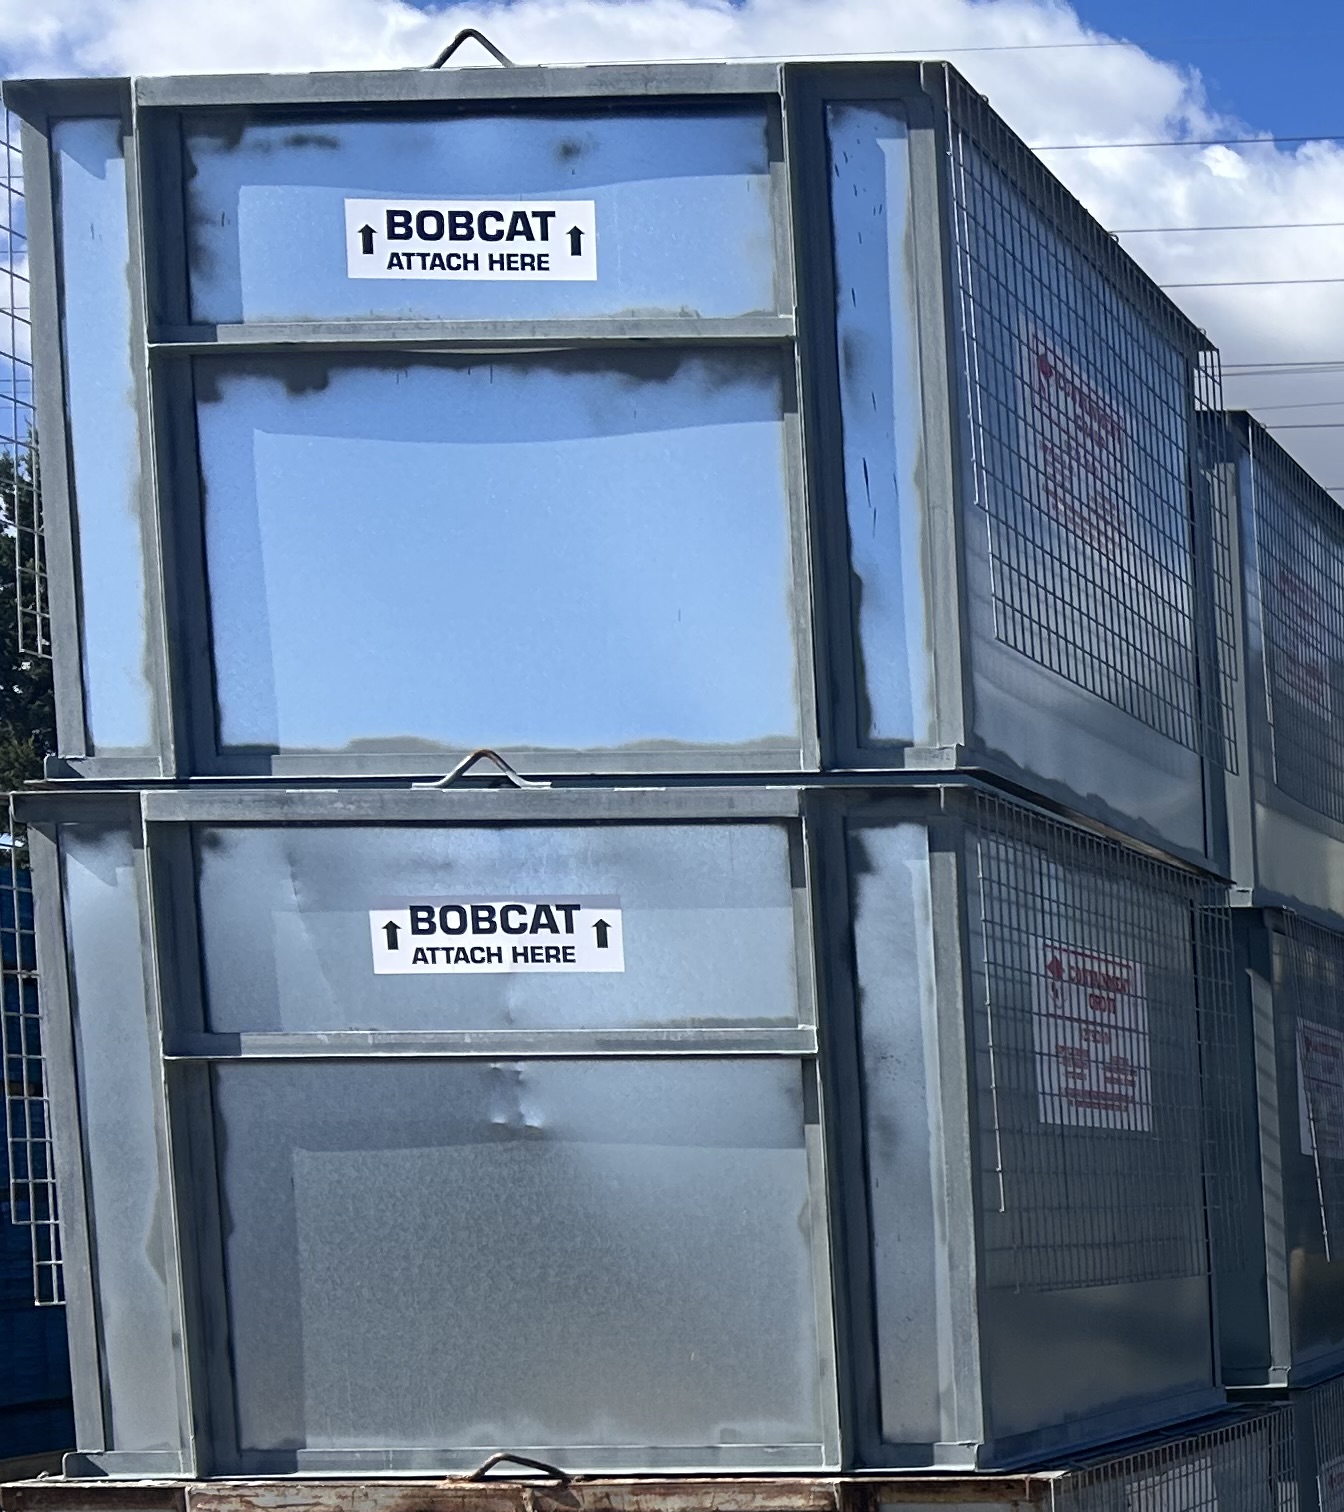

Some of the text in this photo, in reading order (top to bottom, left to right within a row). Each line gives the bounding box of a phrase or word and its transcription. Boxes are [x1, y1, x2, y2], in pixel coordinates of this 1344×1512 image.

[386, 209, 556, 242] BOBCAT
[386, 252, 551, 272] ATTACH HERE
[409, 903, 581, 936] BOBCAT
[412, 945, 577, 964] ATTACH HERE
